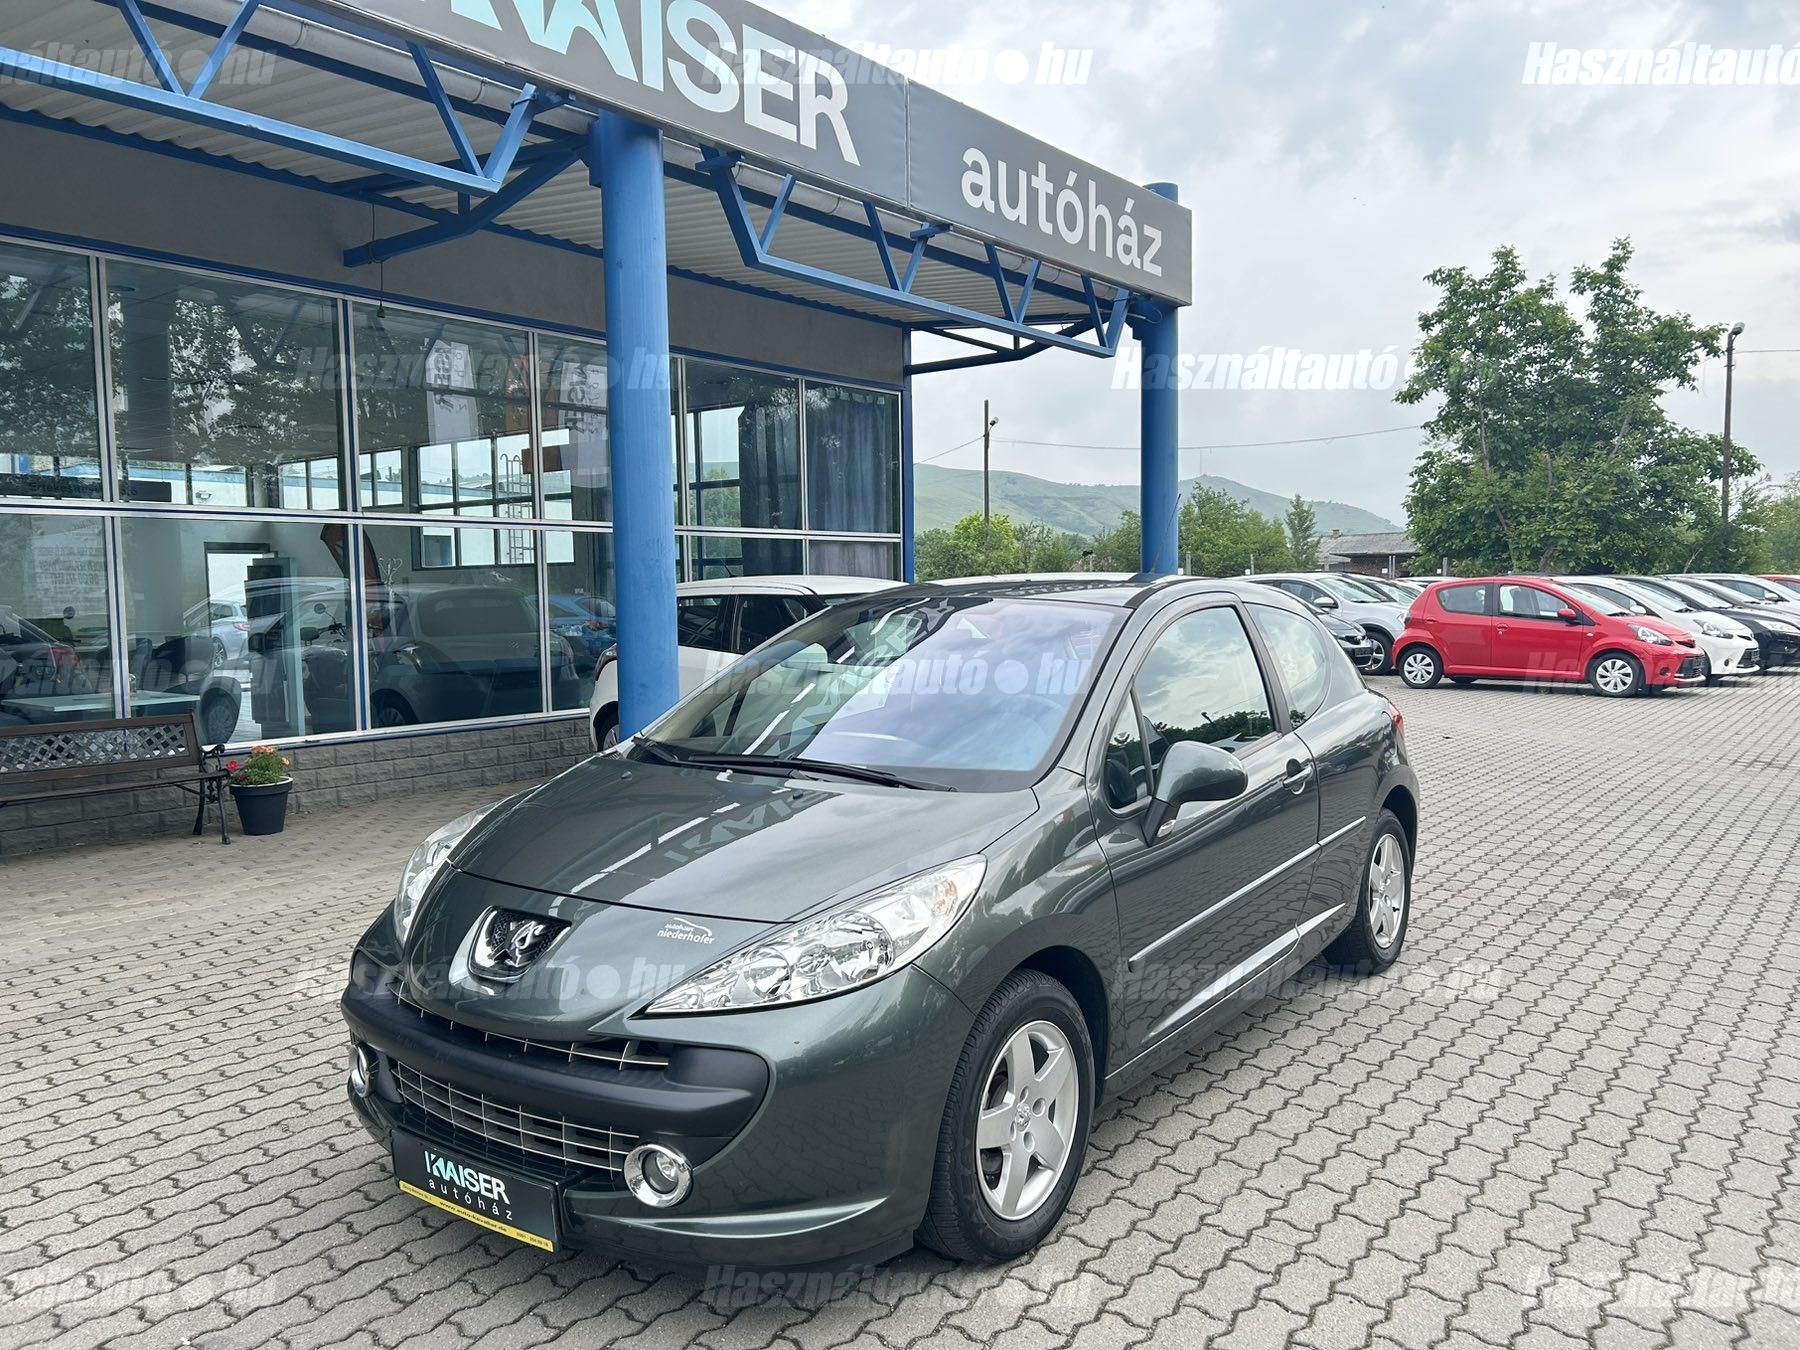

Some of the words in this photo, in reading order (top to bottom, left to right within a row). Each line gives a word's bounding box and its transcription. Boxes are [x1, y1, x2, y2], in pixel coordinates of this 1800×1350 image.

[961, 147, 1162, 277] autóház
[657, 929, 716, 944] niederhofer
[424, 1150, 511, 1205] KAISER
